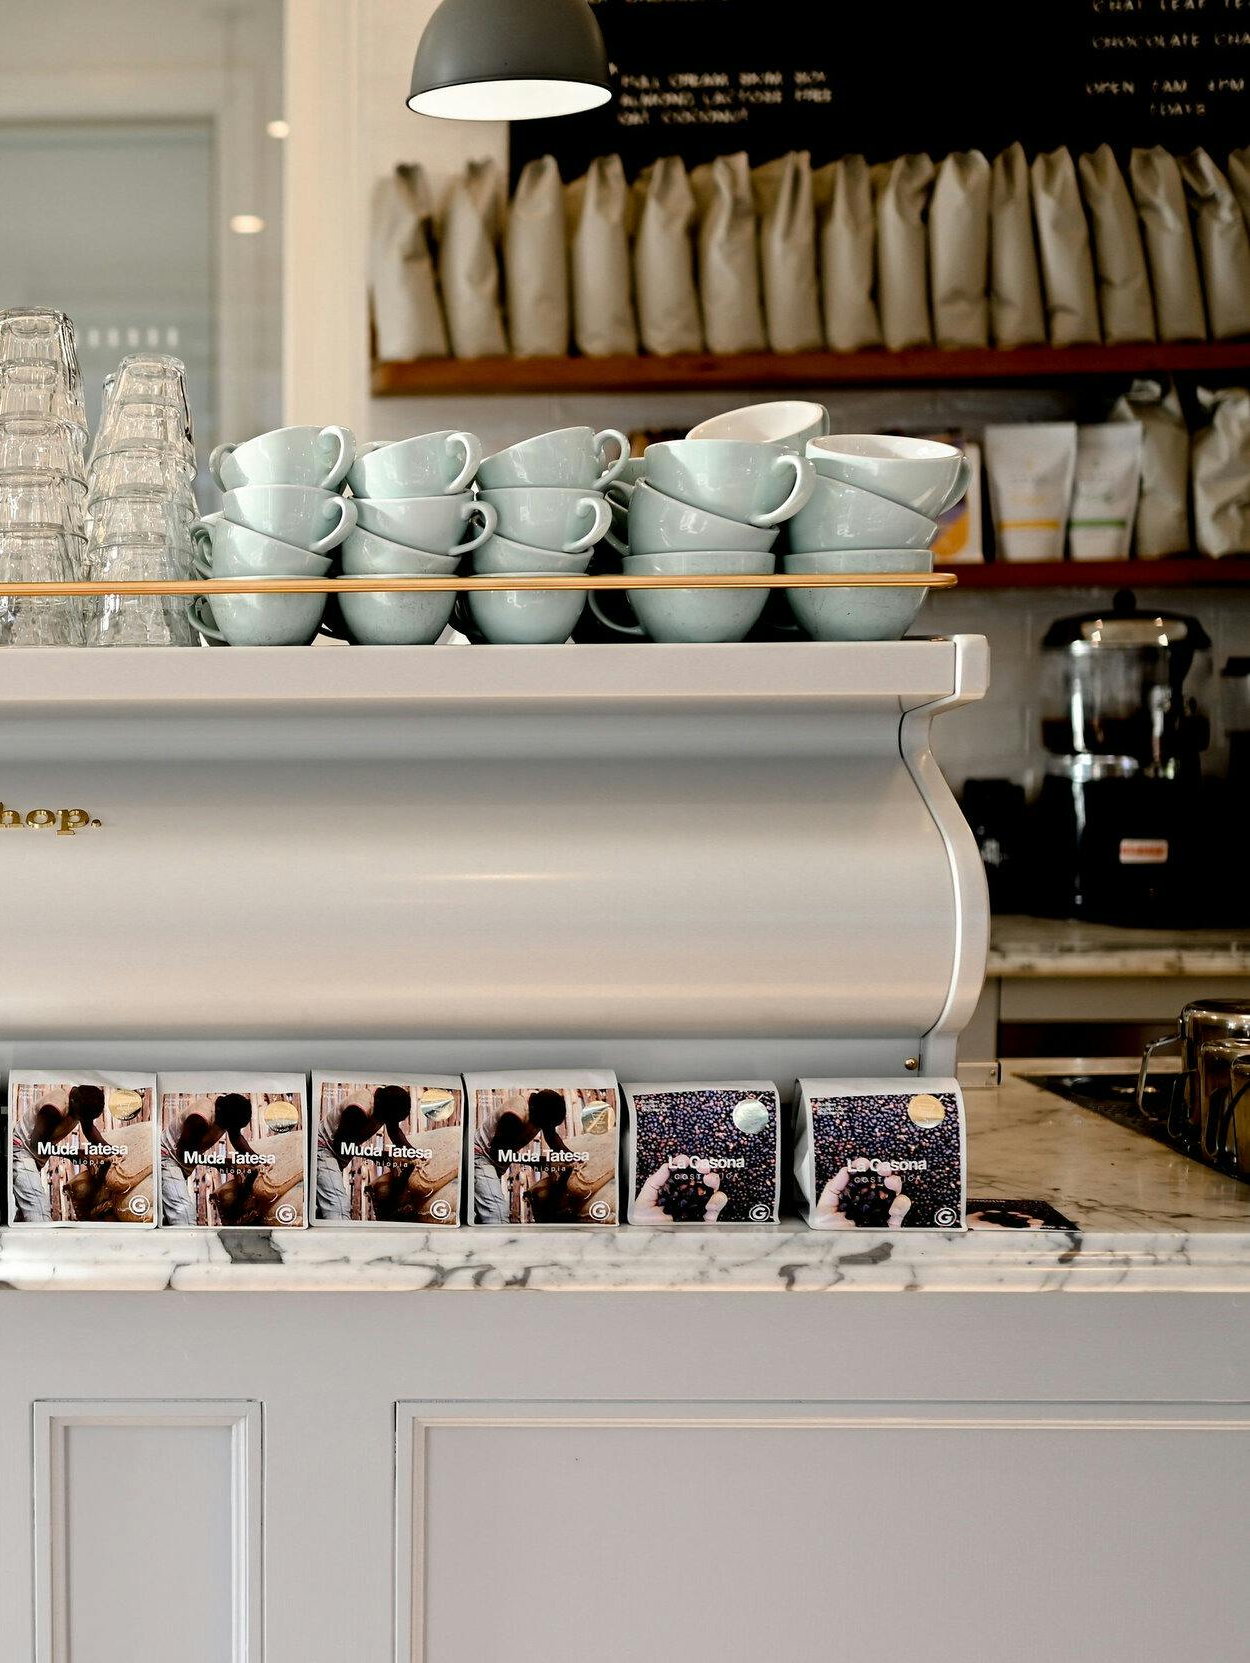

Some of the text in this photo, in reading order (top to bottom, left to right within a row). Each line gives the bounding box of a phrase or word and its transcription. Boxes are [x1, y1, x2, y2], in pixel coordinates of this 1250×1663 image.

[37, 1142, 129, 1155] Muda Tatesa
[340, 1142, 433, 1159] Muda Tatesa
[183, 1151, 276, 1164] Muda Tatesa
[498, 1149, 589, 1162] Muda Tatesa
